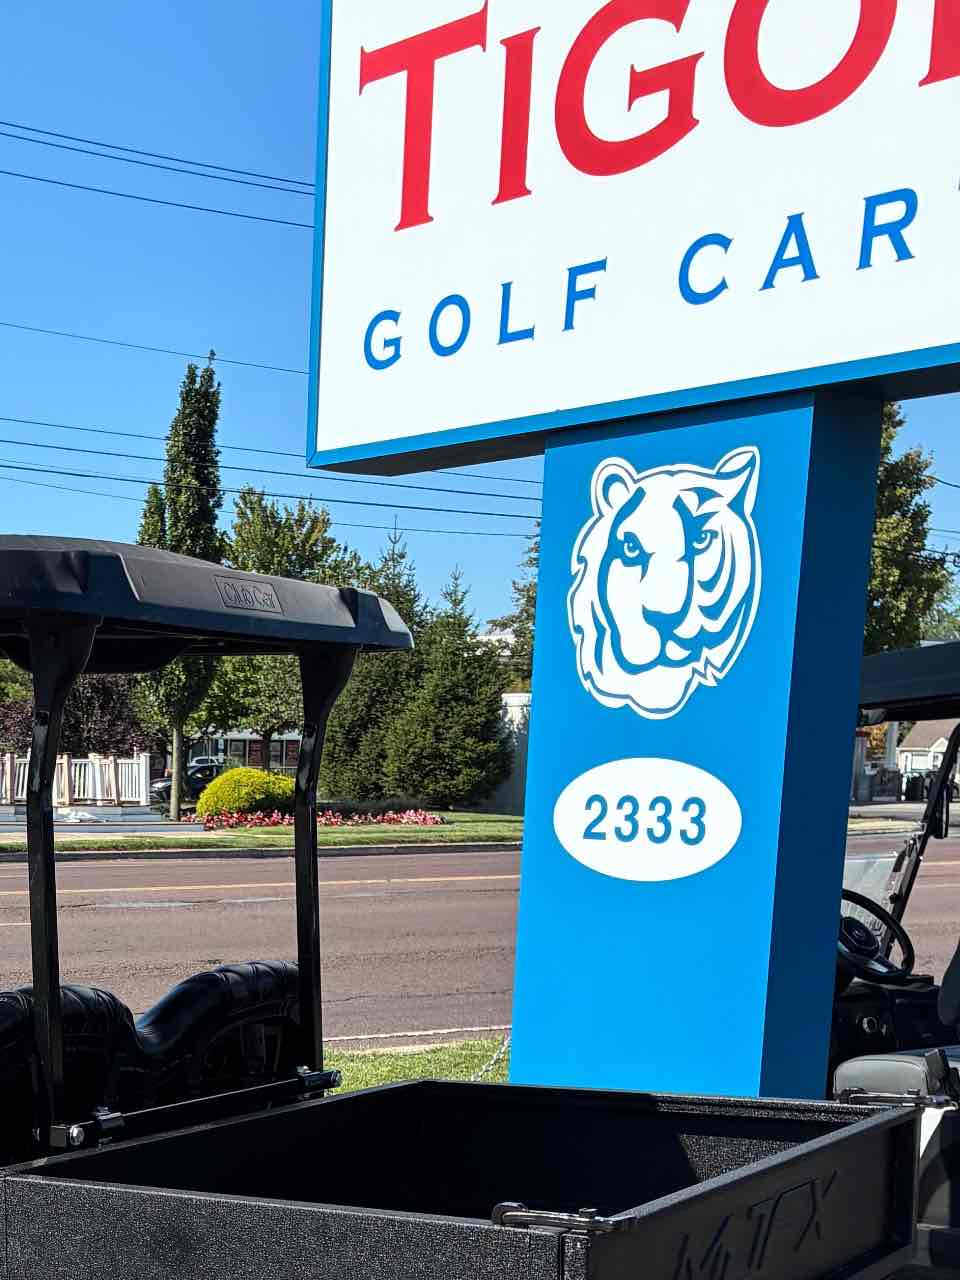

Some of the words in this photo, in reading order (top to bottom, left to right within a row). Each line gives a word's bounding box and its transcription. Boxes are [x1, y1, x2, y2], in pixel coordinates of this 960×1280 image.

[363, 256, 608, 371] GOLF
[678, 176, 960, 305] CAR
[582, 794, 708, 846] 2333
